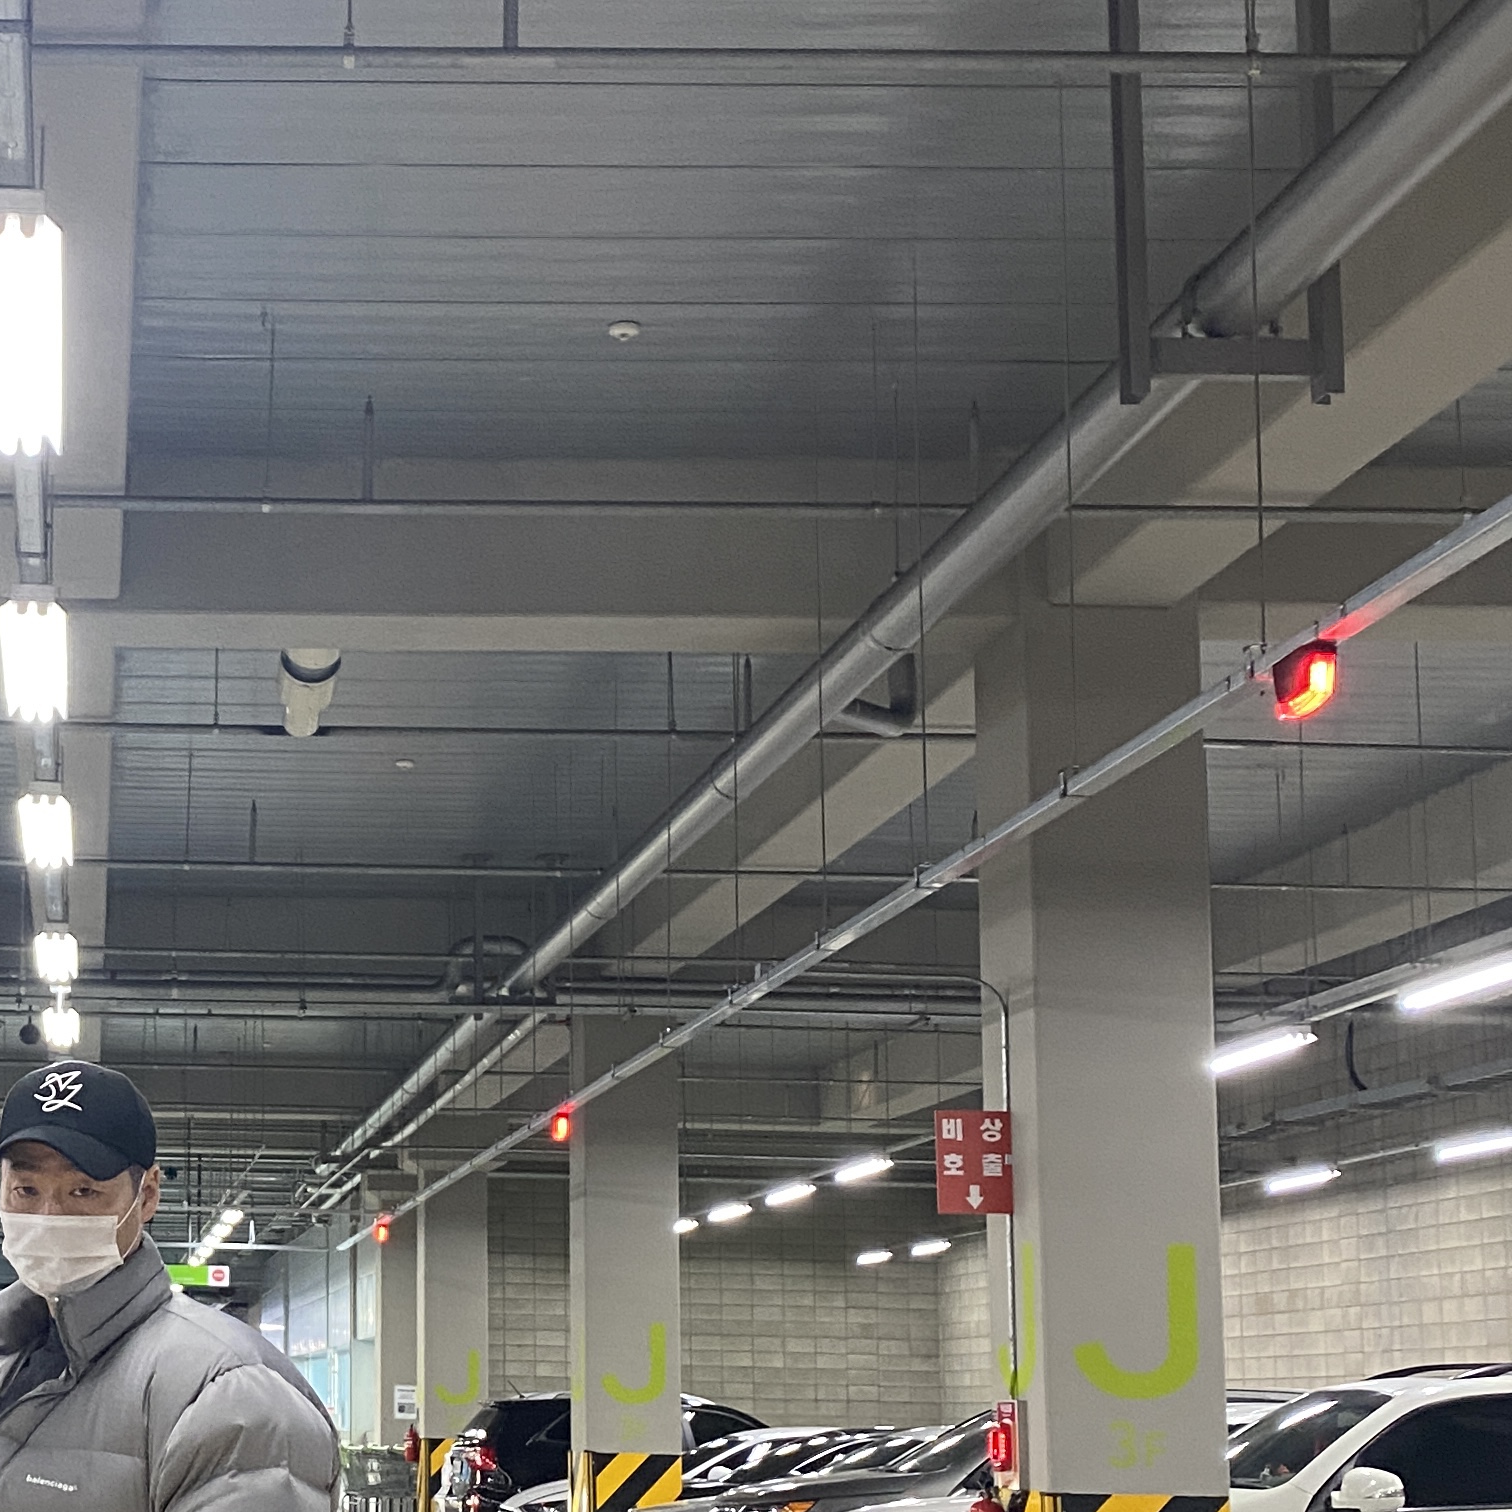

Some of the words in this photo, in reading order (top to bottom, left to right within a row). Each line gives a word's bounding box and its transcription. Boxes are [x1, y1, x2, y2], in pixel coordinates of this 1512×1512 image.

[1073, 1242, 1199, 1400] J
[434, 1348, 480, 1406] J
[600, 1321, 666, 1406] J
[1107, 1420, 1167, 1469] 3F
